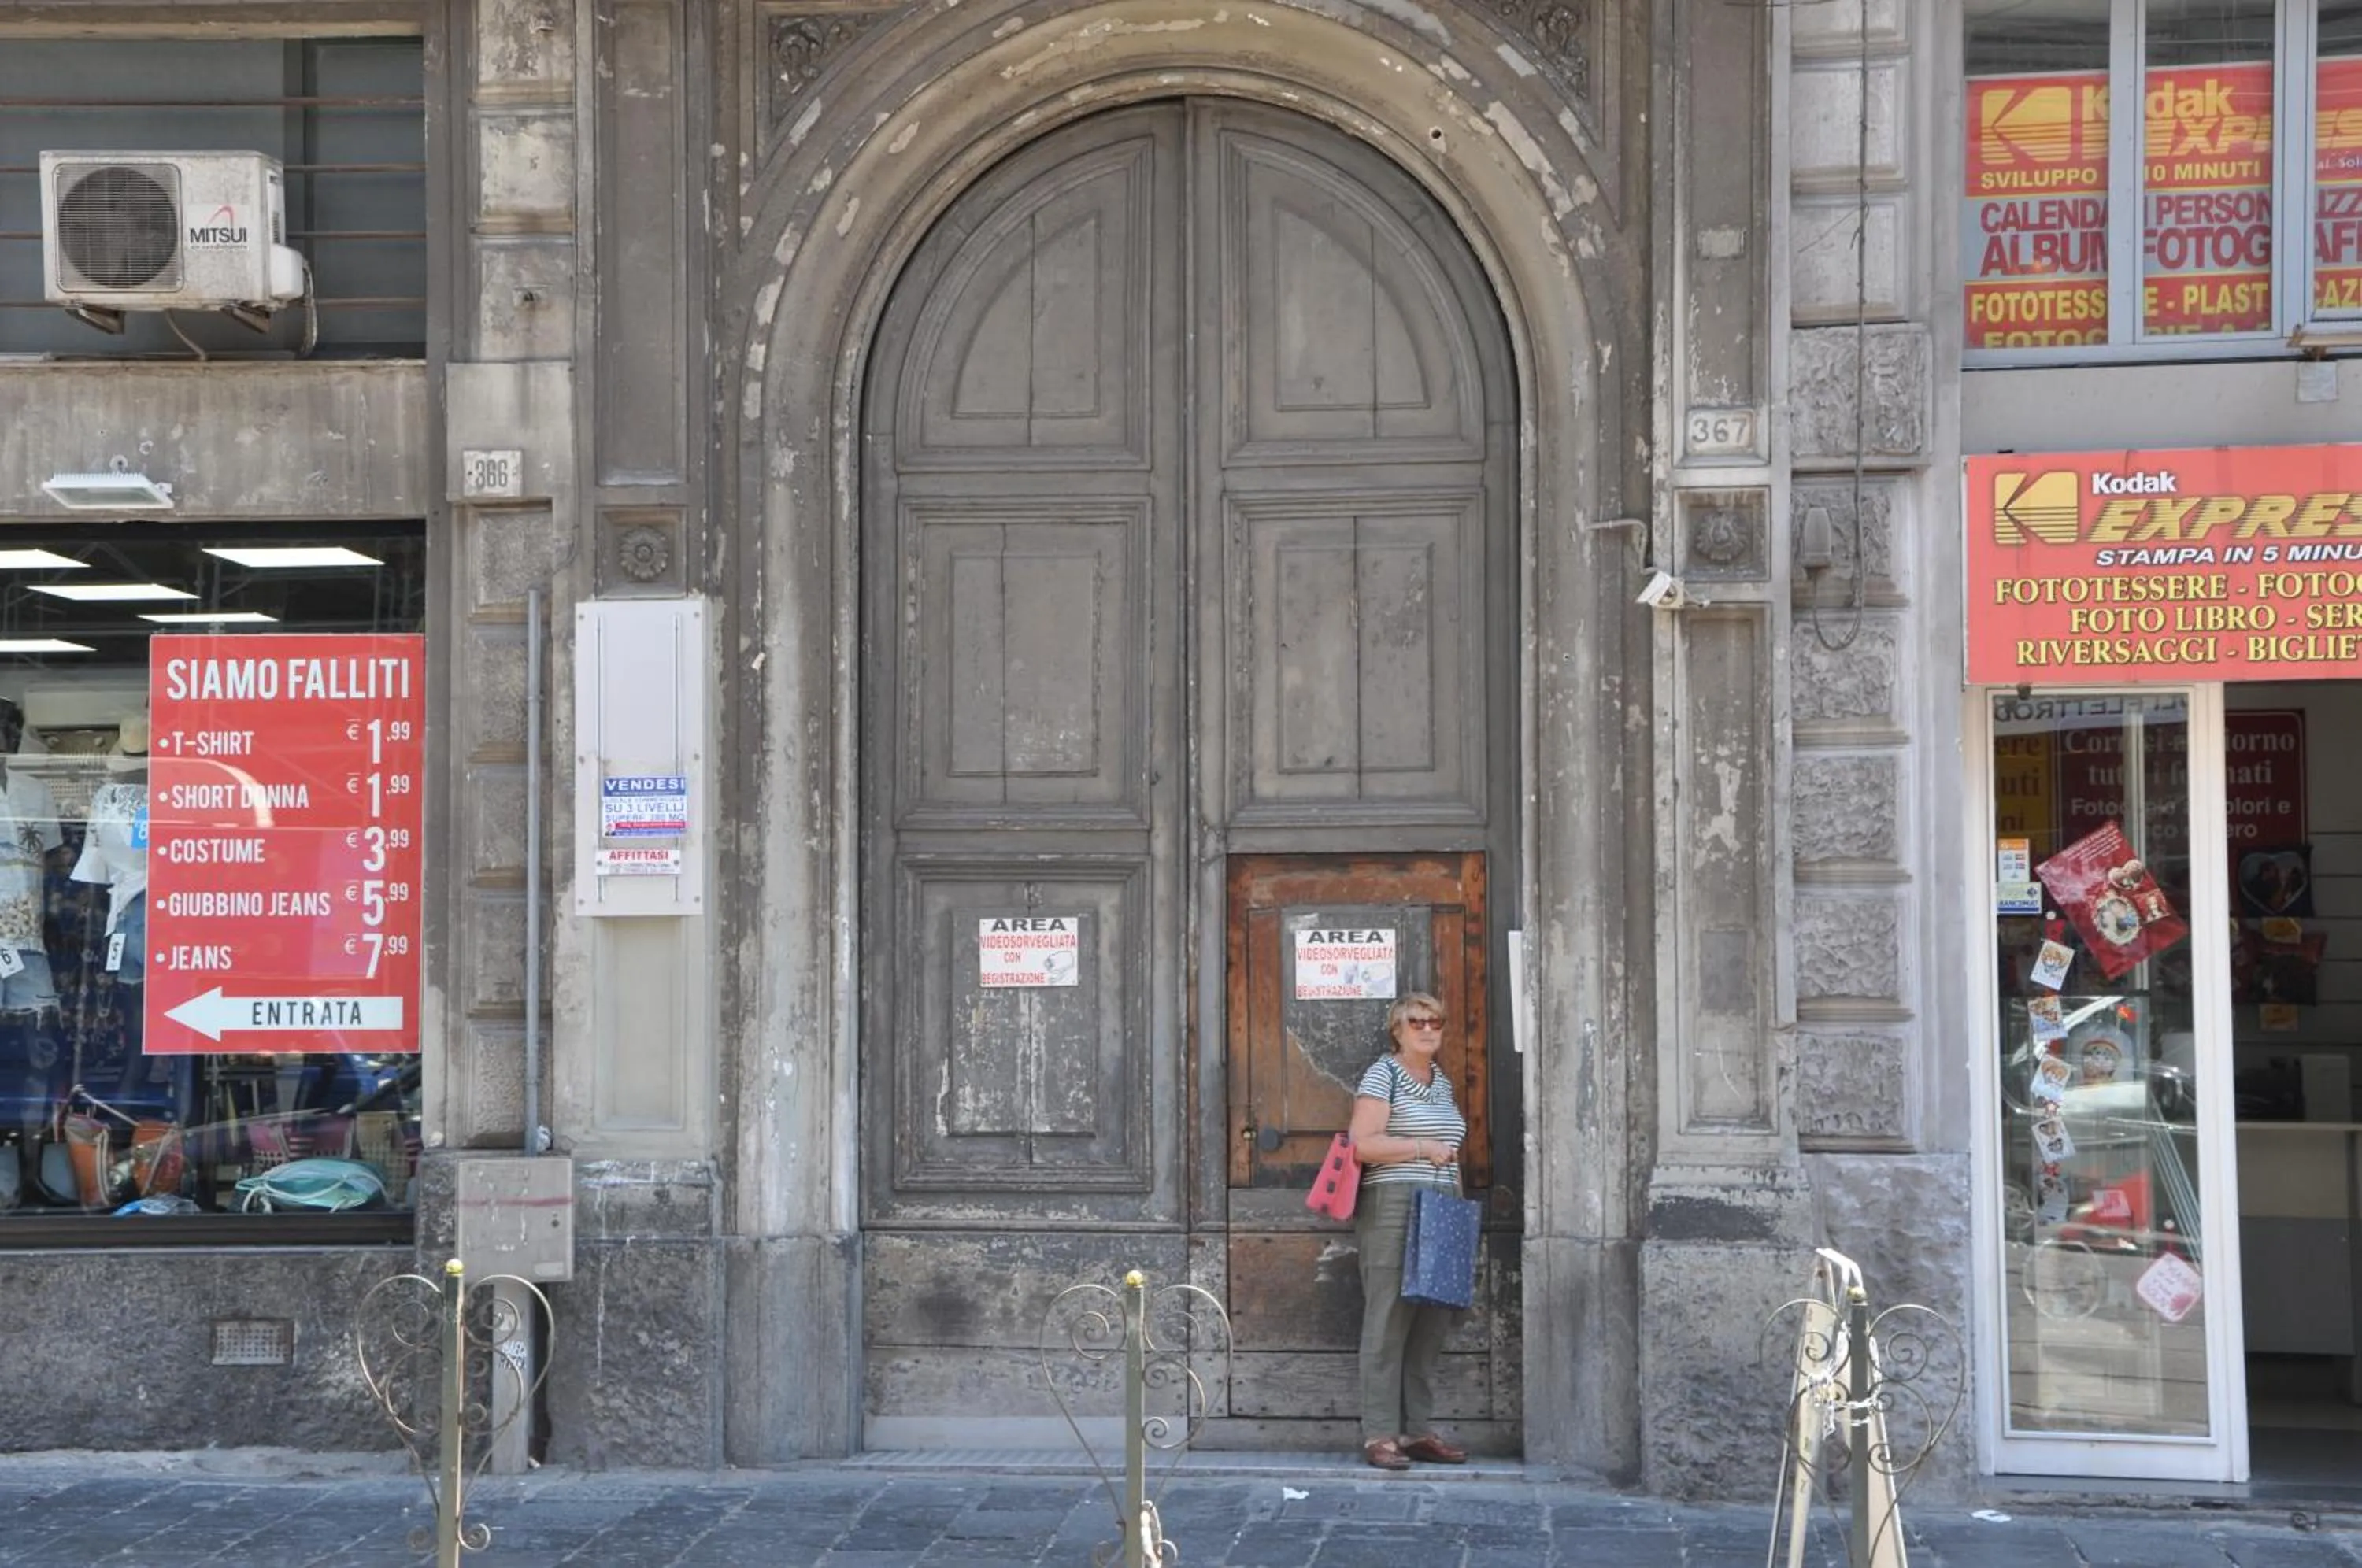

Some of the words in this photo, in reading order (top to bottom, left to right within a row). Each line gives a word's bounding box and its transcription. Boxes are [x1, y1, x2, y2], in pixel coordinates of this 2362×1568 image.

[2082, 80, 2235, 124] Kdak
[1981, 167, 2097, 190] SVILUPPO
[2174, 159, 2261, 181] MINUTI
[189, 227, 247, 244] MITSUI
[1692, 418, 1747, 444] 367
[476, 459, 508, 489] 366
[2091, 471, 2176, 494] Kodak
[2097, 546, 2215, 566] STAMPA
[2223, 545, 2253, 563] IN
[2262, 544, 2279, 562] 5
[1994, 574, 2229, 605] FOTOTESSERE
[2256, 570, 2362, 599] FOTO
[2069, 606, 2166, 634] FOTO
[2175, 604, 2278, 632] LIBRO
[2015, 637, 2218, 666] RIVERSAGGI
[2246, 634, 2362, 663] BIGLIE
[166, 658, 279, 700] SIAMO
[287, 658, 409, 699] FALLITI
[172, 730, 255, 756] T-SHIRT
[171, 783, 236, 809] SHORT
[241, 783, 310, 809] DONNA
[605, 778, 684, 791] VENDESI
[168, 838, 266, 864] COSTUME
[609, 850, 668, 860] AFFITTASI
[168, 892, 264, 917] GIUBBINO
[268, 891, 331, 917] JEANS
[991, 919, 1067, 932] AREA
[1307, 931, 1384, 944] AREA
[980, 934, 1077, 949] VIDEOSORVEGLIATA
[168, 945, 233, 971] JEANS
[1003, 951, 1022, 963] CON
[1320, 963, 1338, 976] CON
[982, 971, 1046, 984] REGISTRAZIONE
[251, 1000, 363, 1026] ENTRATA
